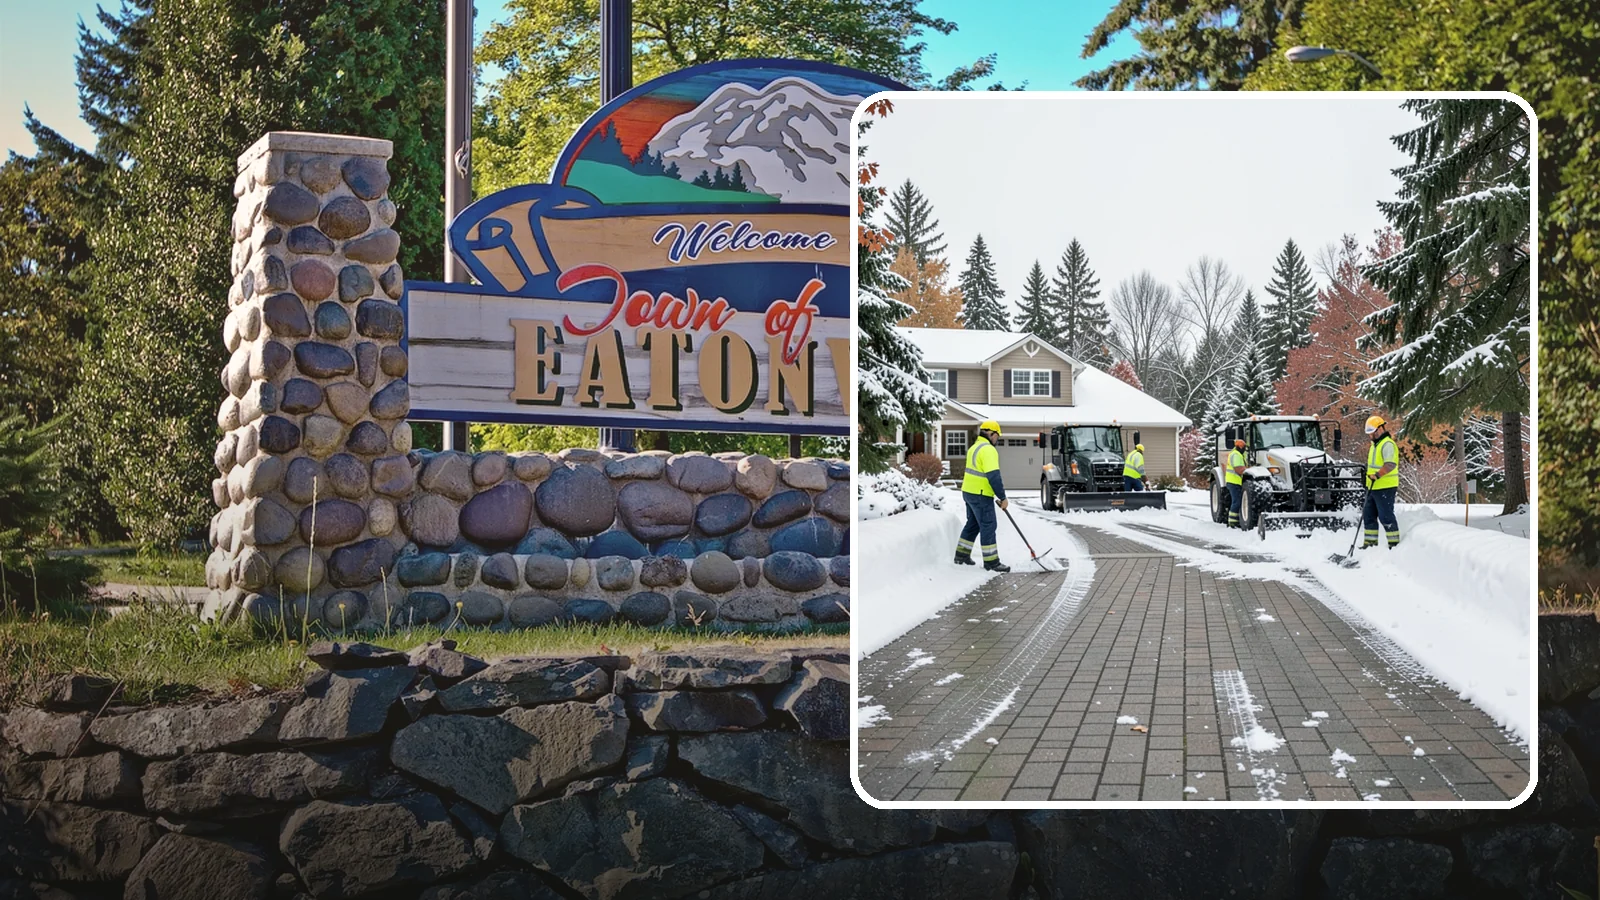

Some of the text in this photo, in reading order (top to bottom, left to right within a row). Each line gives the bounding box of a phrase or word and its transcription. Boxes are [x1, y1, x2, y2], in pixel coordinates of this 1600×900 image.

[653, 221, 836, 263] Welcome
[556, 264, 826, 365] Town of
